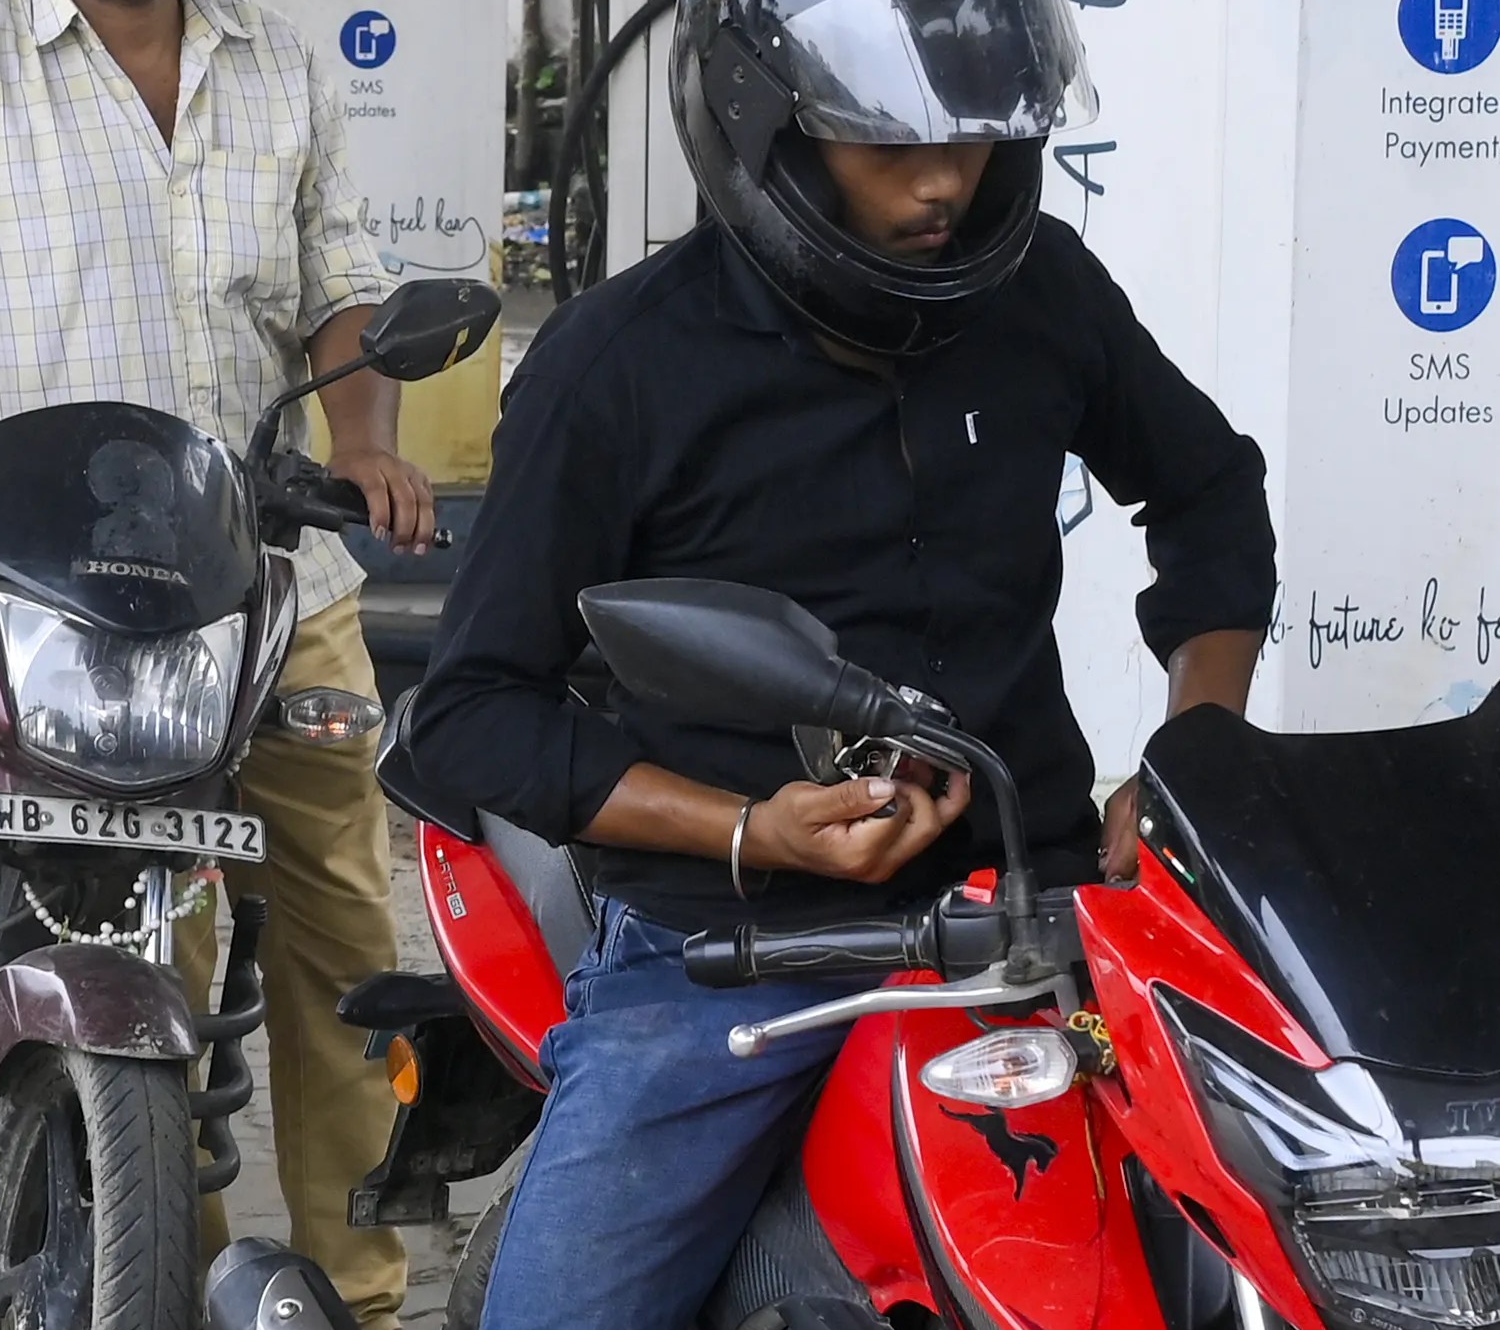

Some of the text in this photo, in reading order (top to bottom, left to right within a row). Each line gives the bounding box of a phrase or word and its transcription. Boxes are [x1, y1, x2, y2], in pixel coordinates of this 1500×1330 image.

[349, 79, 384, 96] SMS
[388, 196, 427, 244] feel
[1408, 353, 1471, 383] SMS
[1382, 397, 1495, 430] Updates
[87, 560, 190, 585] HONDA
[1308, 590, 1404, 670] future
[1421, 577, 1462, 652] ko
[70, 803, 142, 839] 62G
[164, 810, 259, 855] 3122
